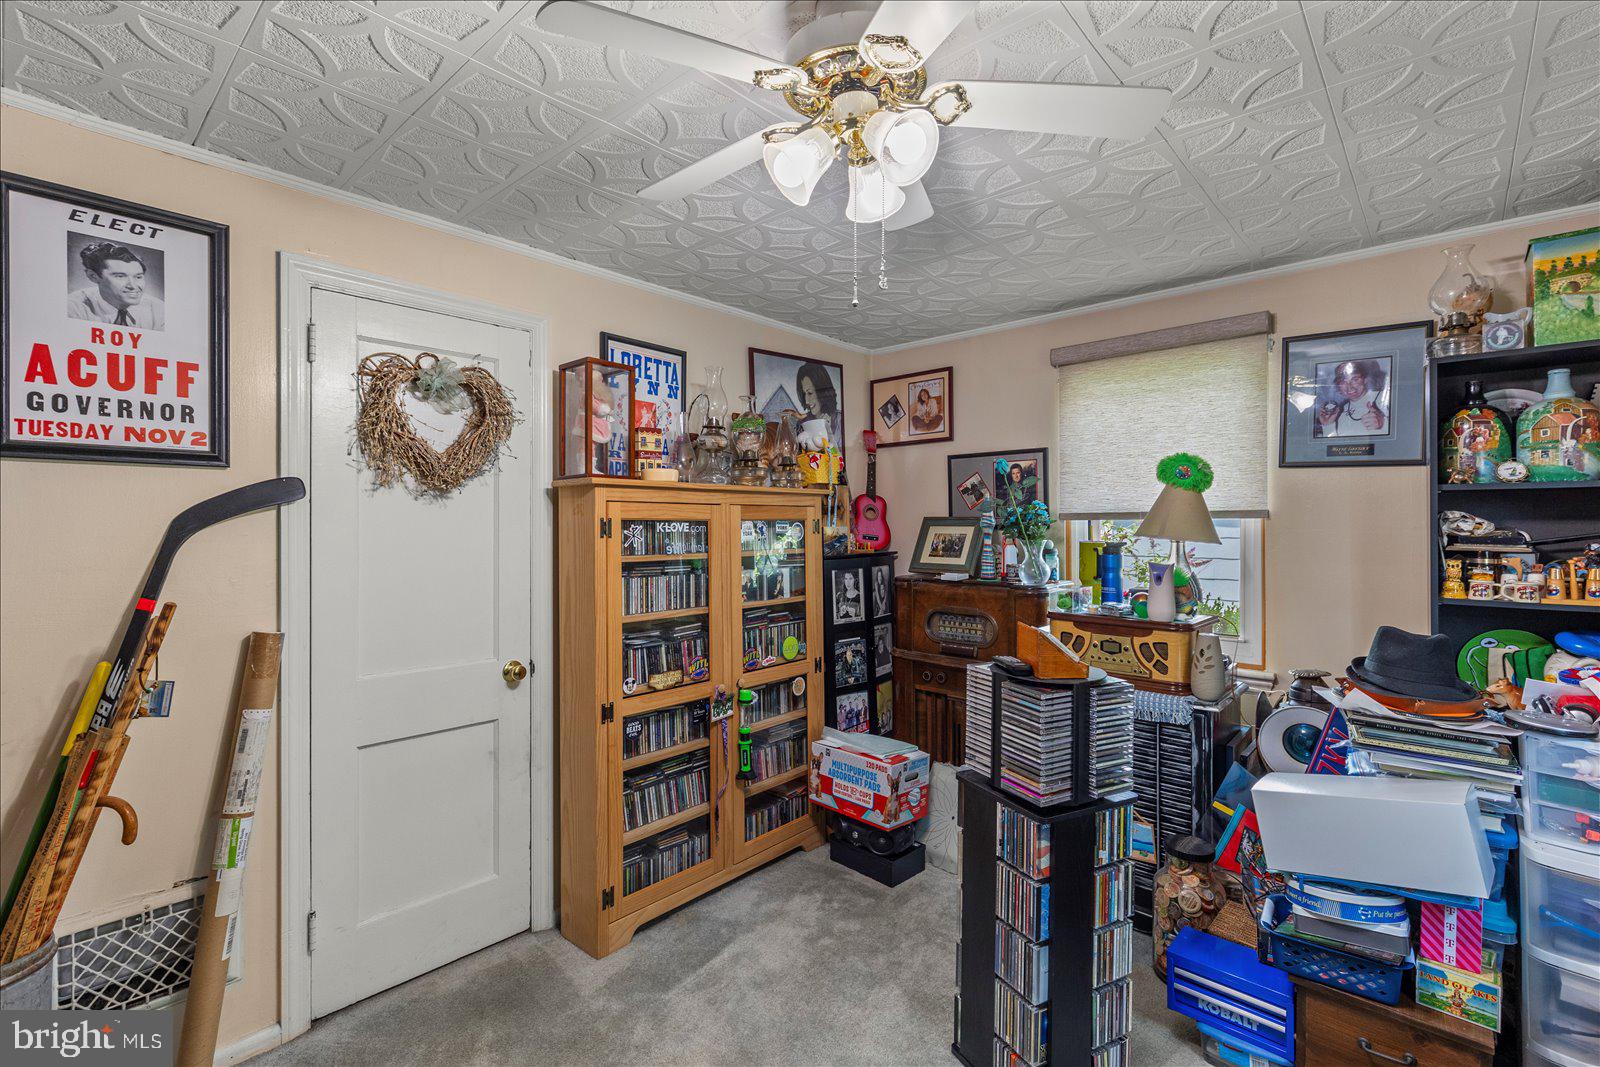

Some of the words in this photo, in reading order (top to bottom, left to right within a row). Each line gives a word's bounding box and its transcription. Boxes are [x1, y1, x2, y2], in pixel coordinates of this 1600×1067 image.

[68, 208, 163, 239] ELECT
[91, 327, 142, 349] ROY
[24, 342, 200, 399] ACUFF
[610, 348, 679, 386] LORETTA
[26, 391, 195, 424] GOVERNOR
[13, 418, 114, 441] TUESDAY
[124, 426, 186, 445] NOV
[190, 431, 208, 447] 2
[626, 724, 642, 735] BEATS
[828, 768, 863, 787] ABSORBENT
[864, 780, 881, 793] PADS
[831, 760, 878, 783] MULTIPURPOSE
[1373, 910, 1384, 918] Put
[1419, 970, 1449, 987] LAND
[1198, 997, 1260, 1032] KOBALT
